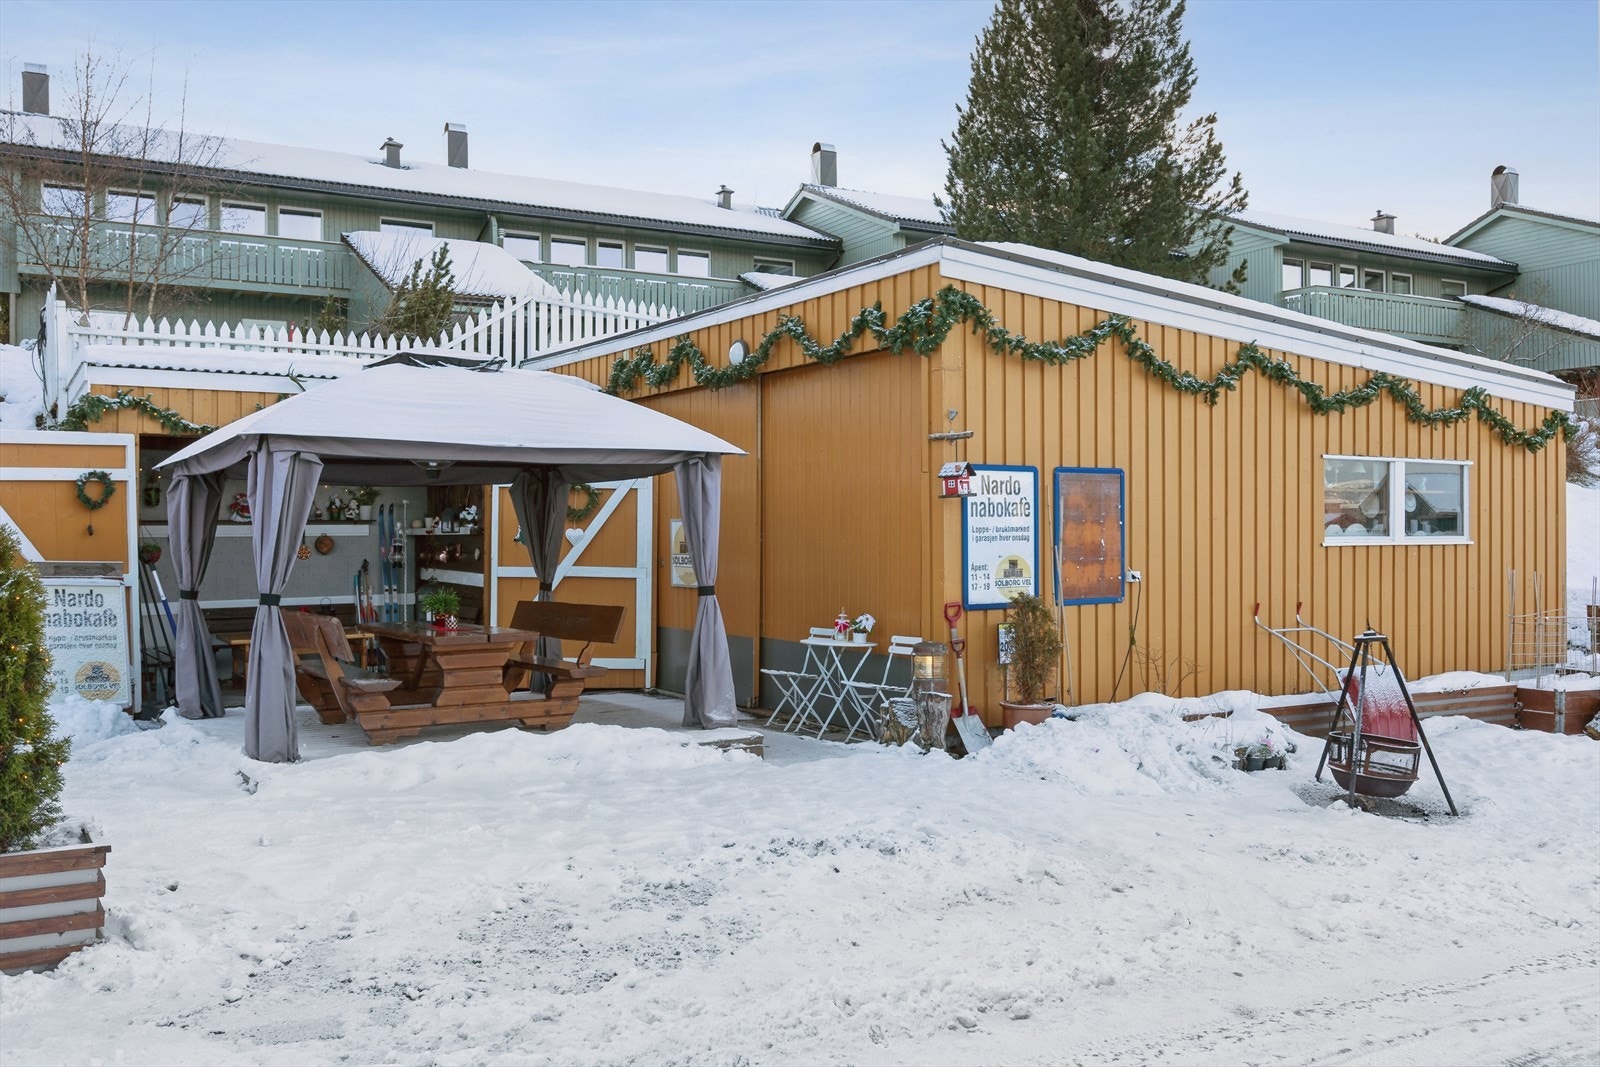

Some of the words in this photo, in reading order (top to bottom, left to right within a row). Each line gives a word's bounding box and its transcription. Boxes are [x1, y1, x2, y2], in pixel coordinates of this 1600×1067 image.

[981, 475, 1021, 495] Nardo
[974, 534, 998, 543] garasjen
[1012, 534, 1030, 542] onsdag
[984, 582, 990, 590] 19
[54, 588, 104, 608] Nardo
